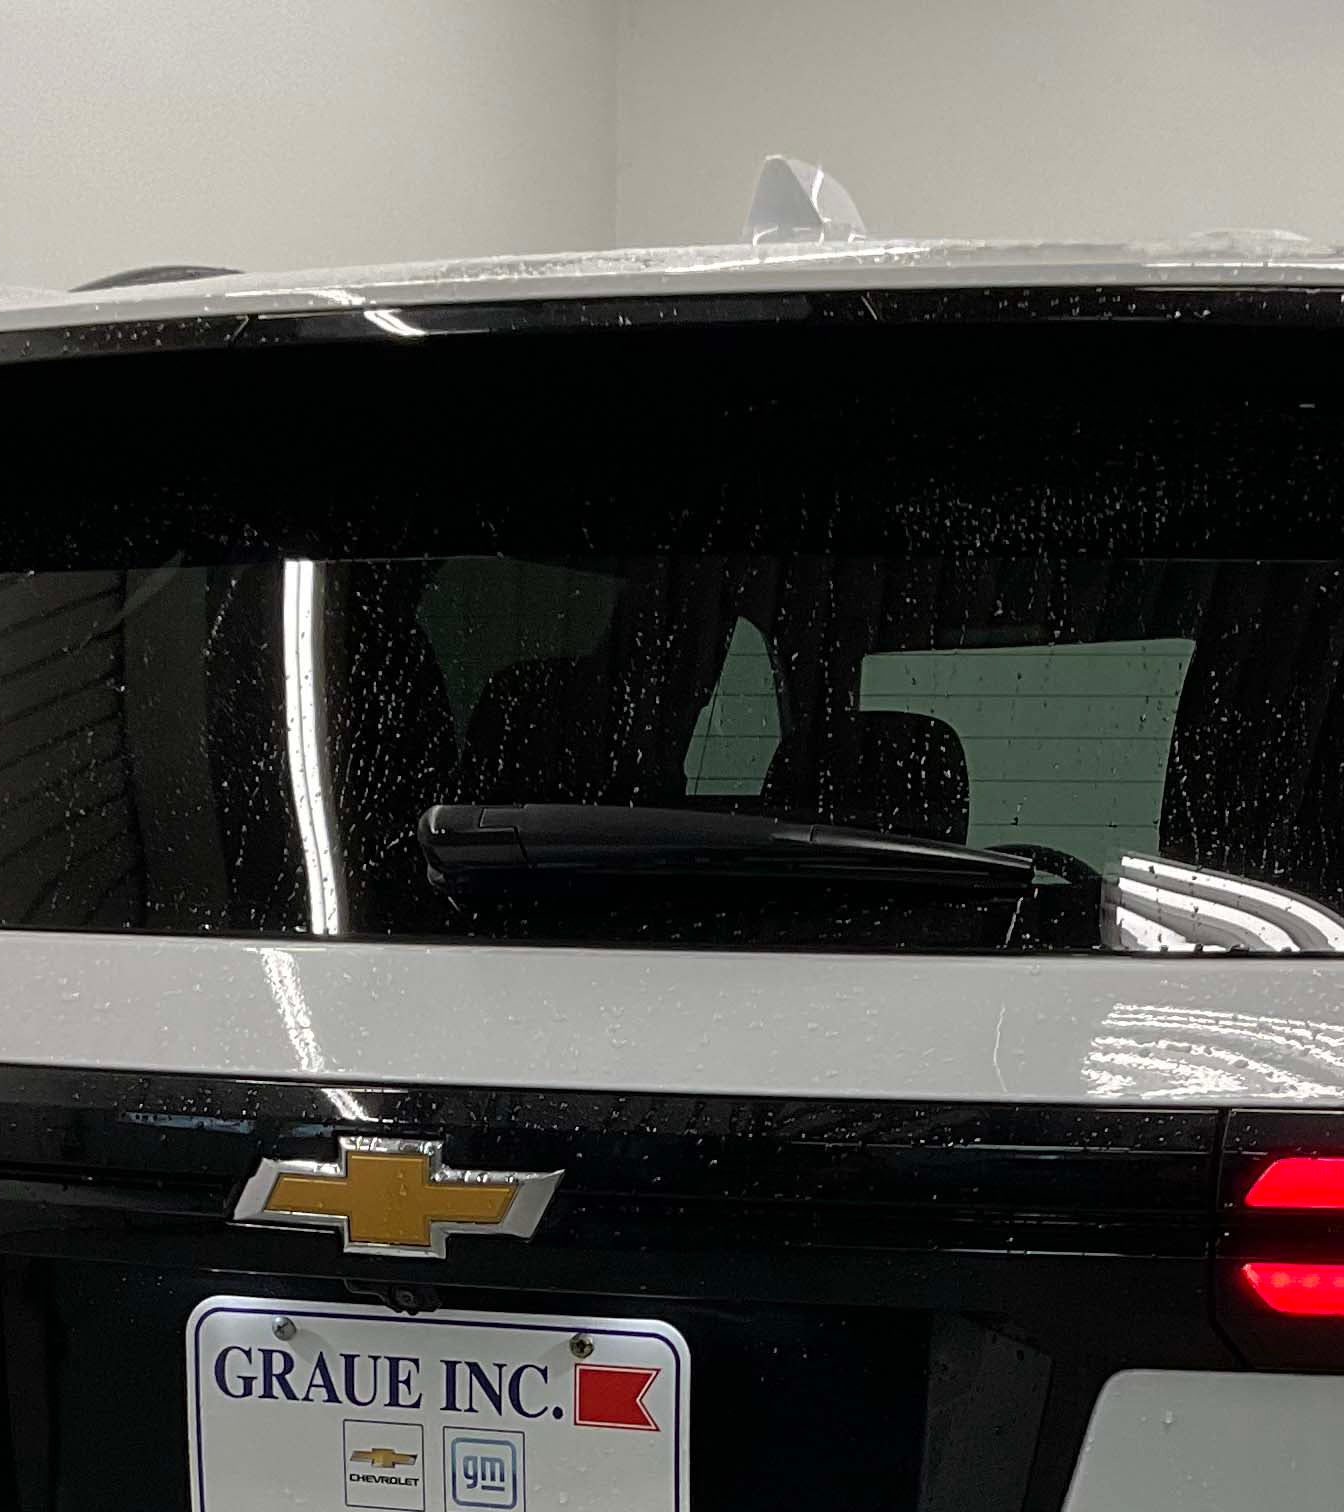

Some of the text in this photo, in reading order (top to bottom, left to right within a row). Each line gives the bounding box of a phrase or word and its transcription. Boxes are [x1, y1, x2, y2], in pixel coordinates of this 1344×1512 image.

[214, 1344, 565, 1420] GRAUE INC.
[349, 1473, 420, 1487] CHEVROLET
[463, 1455, 506, 1491] gm
